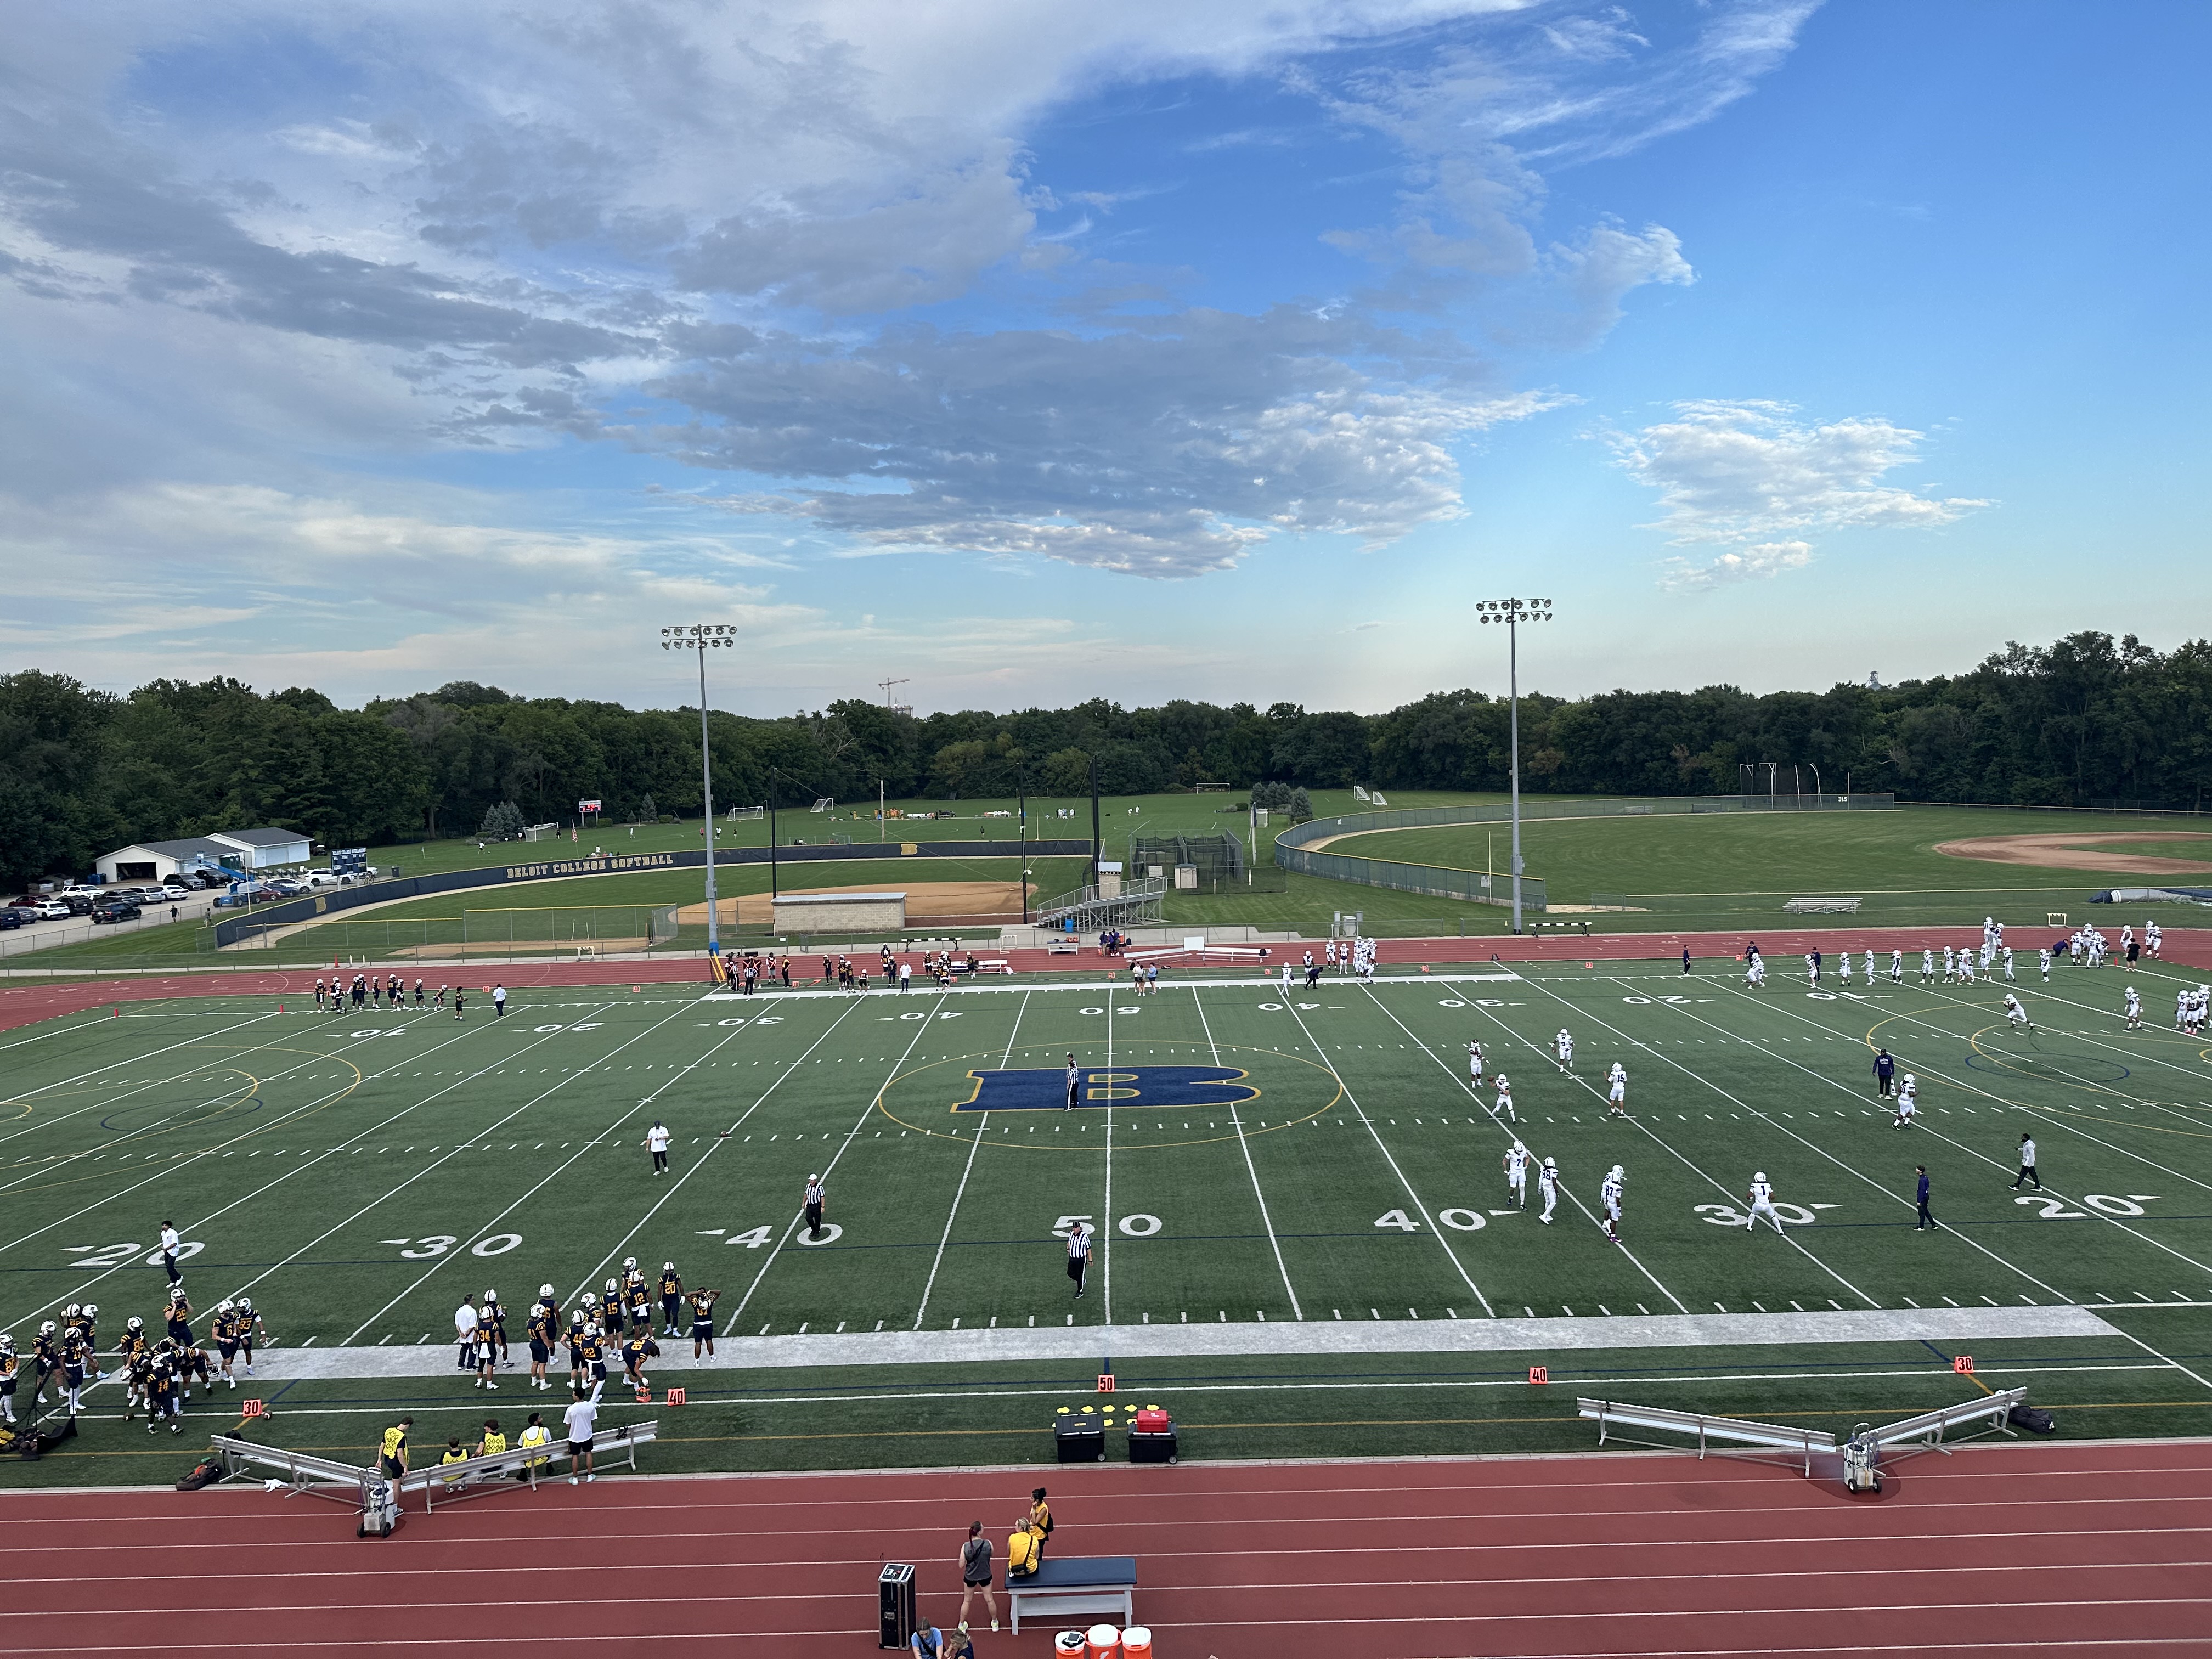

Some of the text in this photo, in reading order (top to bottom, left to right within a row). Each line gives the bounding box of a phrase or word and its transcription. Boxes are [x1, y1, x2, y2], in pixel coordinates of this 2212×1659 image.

[901, 844, 917, 855] B
[507, 855, 673, 878] BELOIT COLLEGE SOFTBALL
[315, 896, 326, 913] B
[950, 1065, 1261, 1113] B
[1542, 1170, 1550, 1180] 88
[1760, 1185, 1765, 1195] 1
[665, 1284, 675, 1294] 20
[633, 1293, 645, 1305] 12
[607, 1302, 618, 1315] 15
[227, 1325, 233, 1336] 6
[239, 1320, 252, 1330] 83
[479, 1330, 491, 1341] 34
[1958, 1358, 1972, 1370] 30
[1532, 1369, 1545, 1382] 40
[157, 1381, 169, 1393] 14
[1100, 1377, 1113, 1390] 50
[669, 1391, 683, 1404] 40
[244, 1401, 258, 1414] 30
